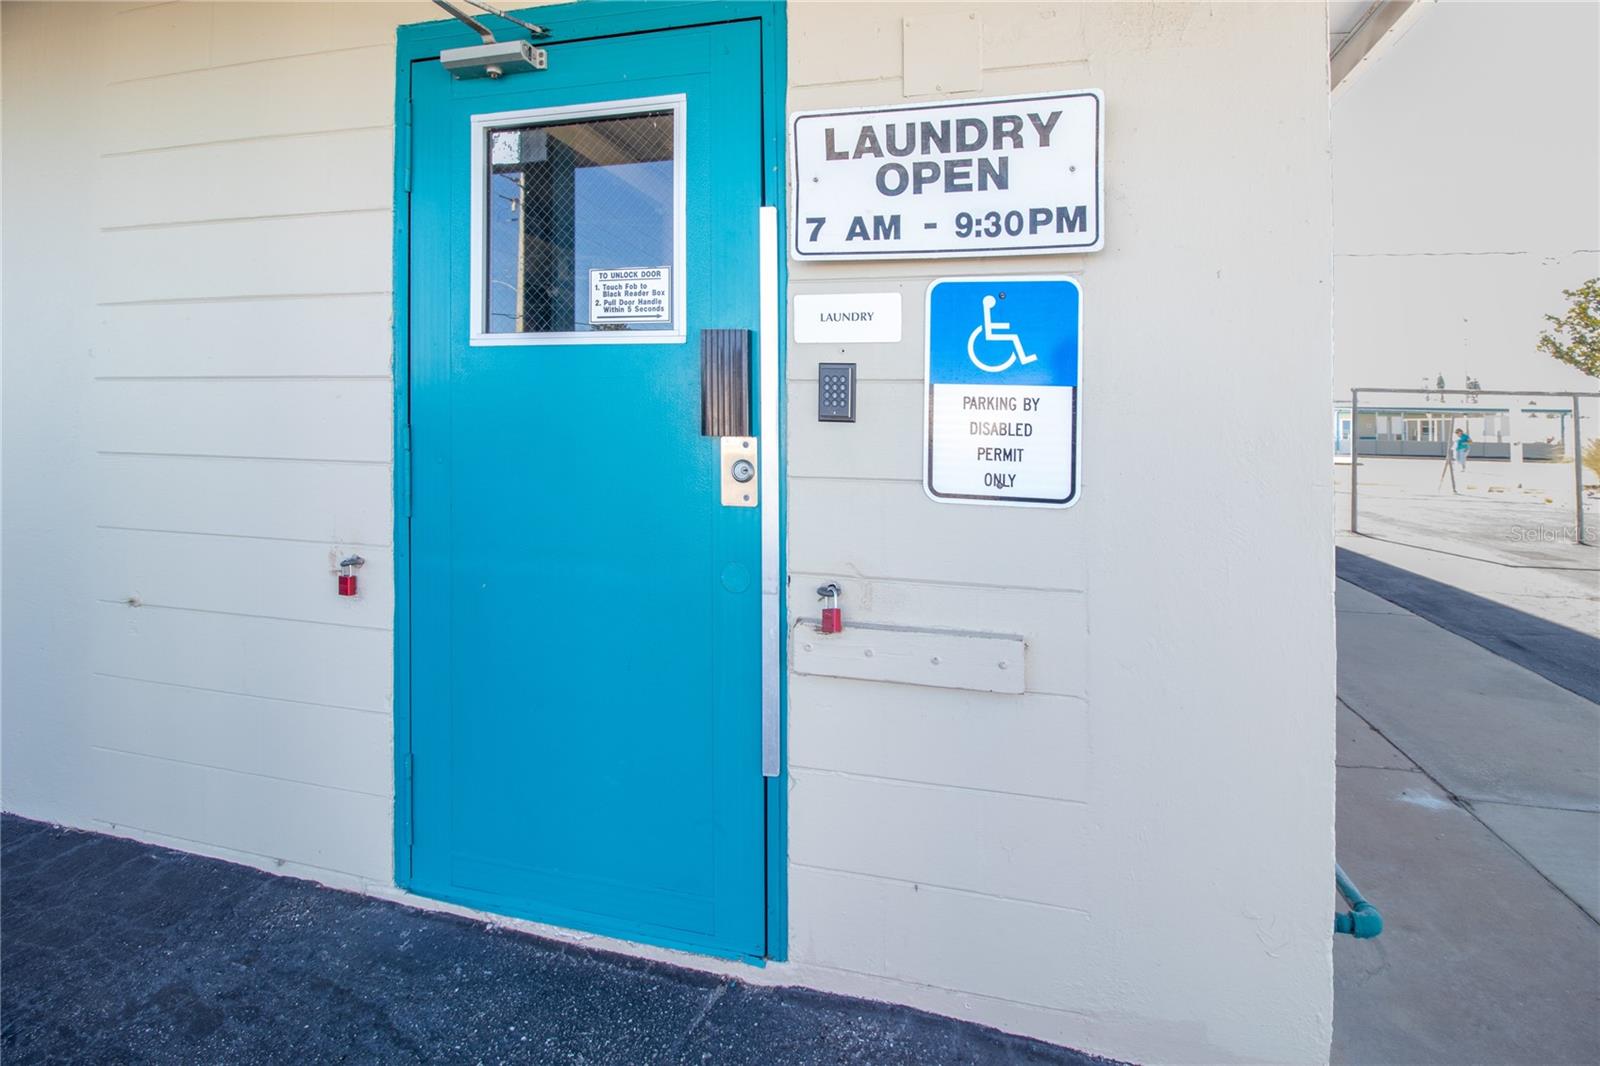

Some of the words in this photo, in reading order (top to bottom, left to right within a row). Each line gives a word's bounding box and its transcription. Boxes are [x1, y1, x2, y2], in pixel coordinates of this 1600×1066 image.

[824, 110, 1063, 161] LAUNDRY
[875, 156, 1009, 197] OPEN
[805, 216, 827, 242] 7
[845, 214, 901, 242] AM
[610, 271, 638, 279] UNLOCK
[641, 270, 661, 278] DOOR
[603, 283, 623, 291] Touch
[820, 312, 874, 322] LAUNDRY
[962, 396, 1017, 412] PARKING
[1023, 397, 1040, 412] BY
[969, 421, 1033, 437] DISABLED
[977, 447, 1024, 463] PERMIT
[984, 472, 1017, 488] ONLY
